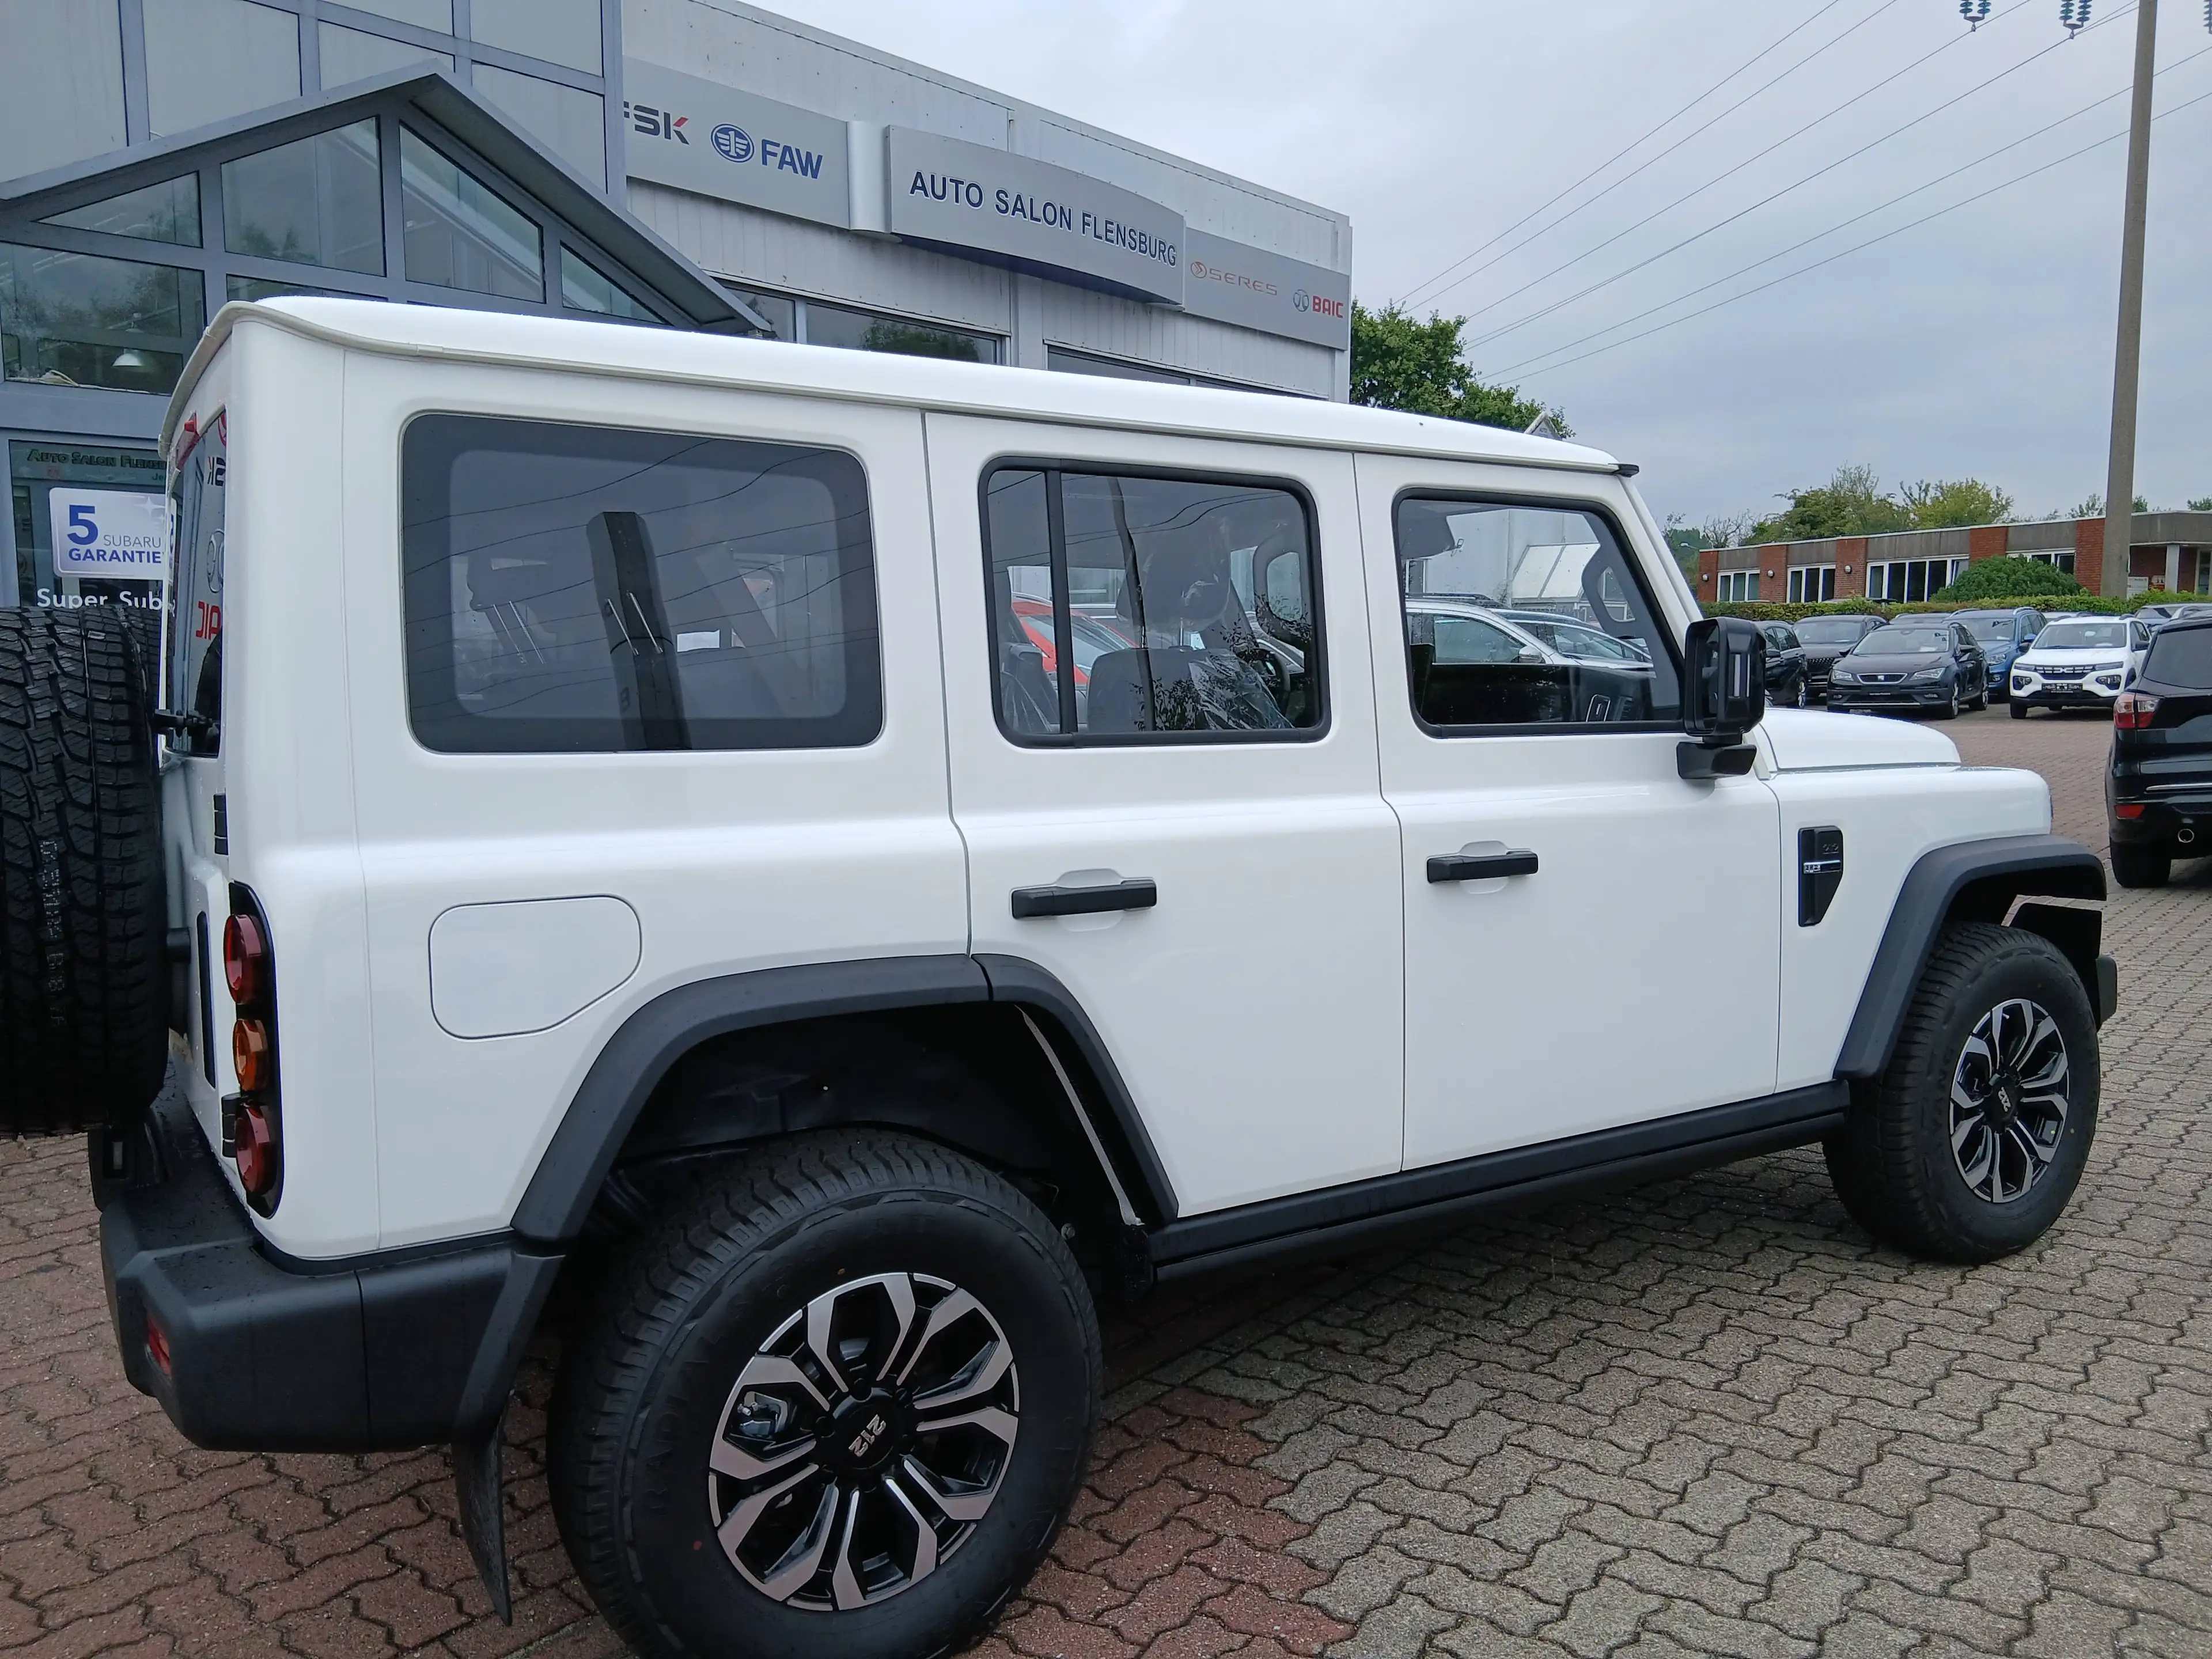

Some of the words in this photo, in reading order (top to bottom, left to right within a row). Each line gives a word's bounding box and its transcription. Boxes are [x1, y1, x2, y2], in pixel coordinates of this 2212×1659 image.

[762, 138, 823, 179] FAW
[910, 171, 983, 209] AUTO
[995, 188, 1072, 232] SALON
[1082, 211, 1177, 266] FLENSBURG
[1209, 269, 1278, 296] SERES
[1312, 296, 1344, 319] BAIC
[67, 505, 99, 546] 5
[104, 535, 162, 548] SUBARU
[69, 548, 162, 564] GARANTIE
[37, 588, 108, 609] Super
[119, 590, 163, 611] Sub
[848, 1414, 887, 1458] 212
